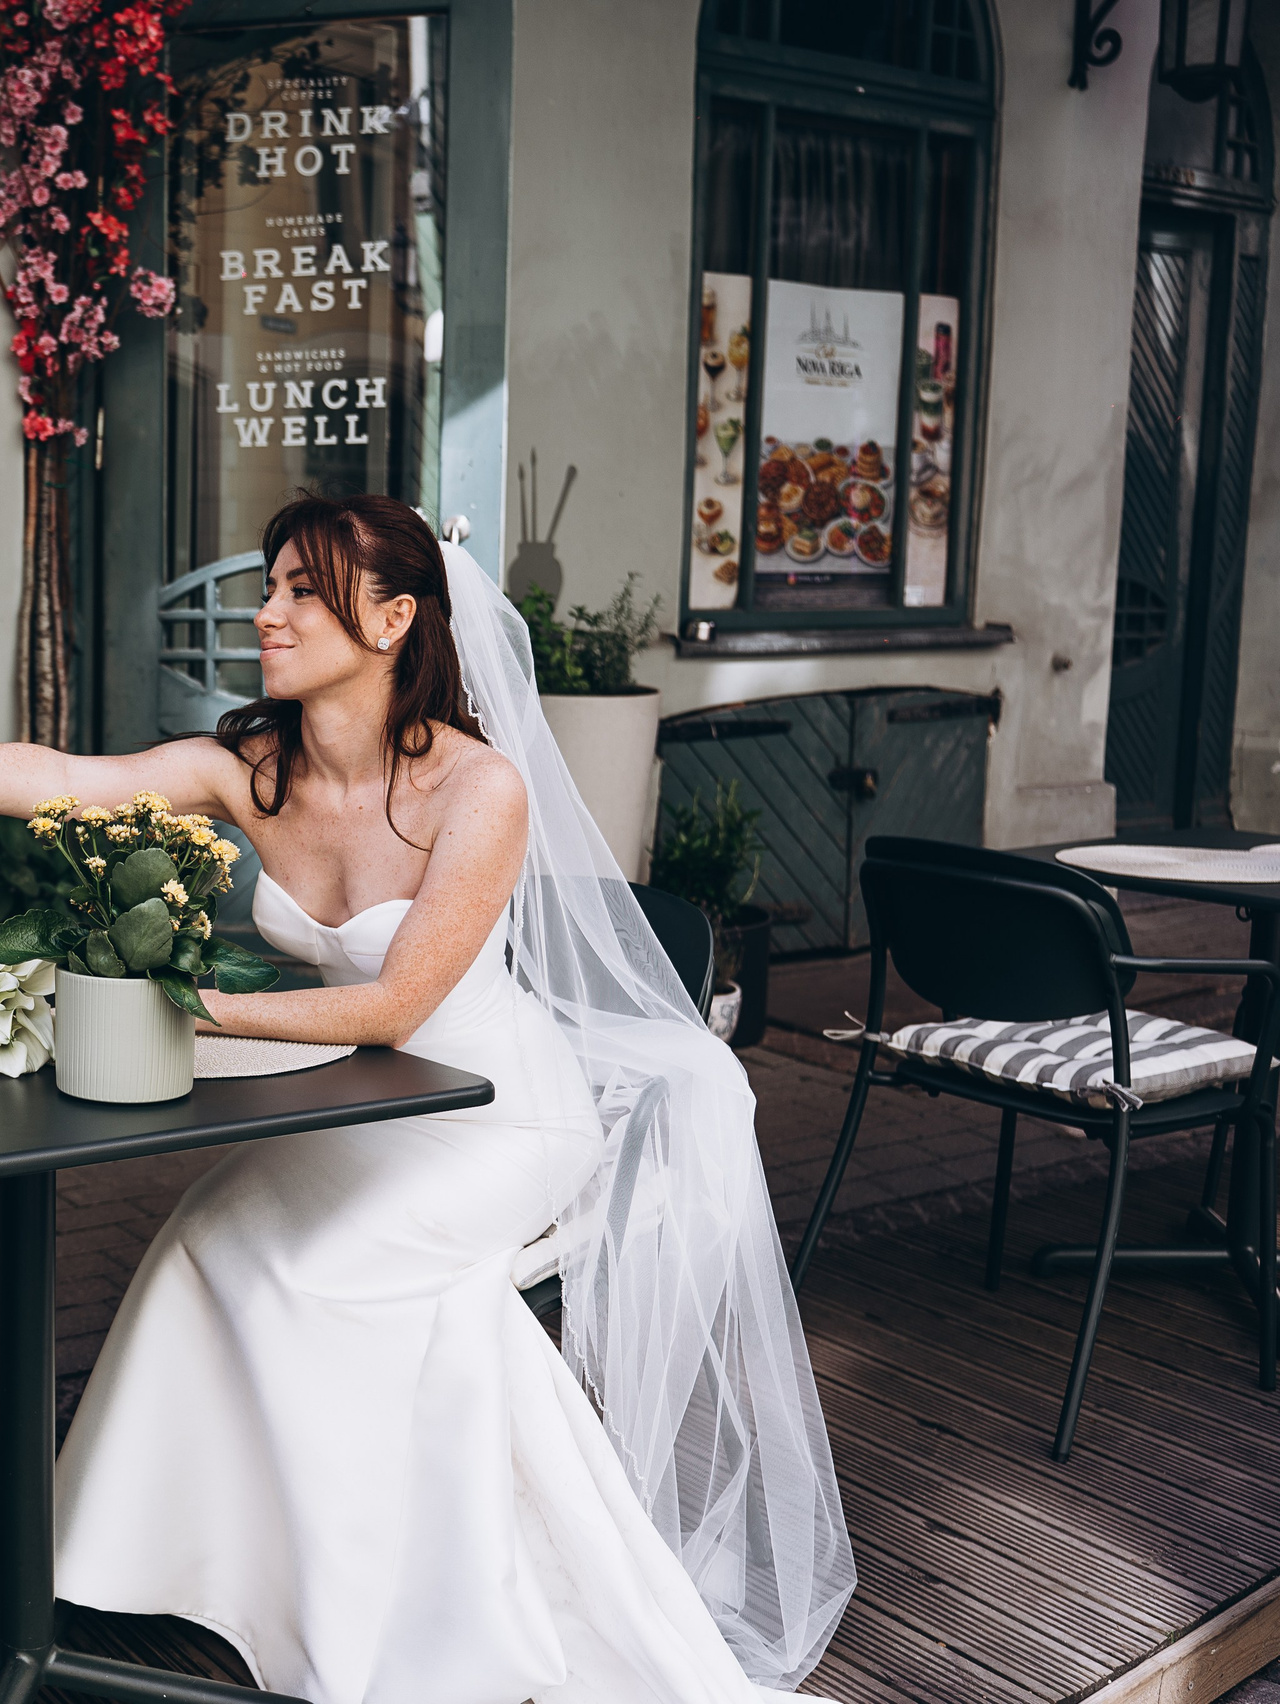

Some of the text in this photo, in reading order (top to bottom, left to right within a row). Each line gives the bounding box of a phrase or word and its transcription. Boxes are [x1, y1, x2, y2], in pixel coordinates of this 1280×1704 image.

[267, 75, 350, 90] SPECIALITY
[280, 89, 334, 101] COFFEE
[224, 104, 390, 143] DRINK
[255, 142, 357, 178] HOT
[265, 212, 344, 228] HOMEMADE
[282, 226, 327, 239] CAKES
[220, 240, 391, 282] BREAK
[242, 277, 368, 316] FAST
[255, 347, 347, 362] SANDWICHES
[258, 360, 344, 374] & HOT FOOD
[215, 376, 388, 414] LUNCH
[232, 413, 369, 448] WELL
